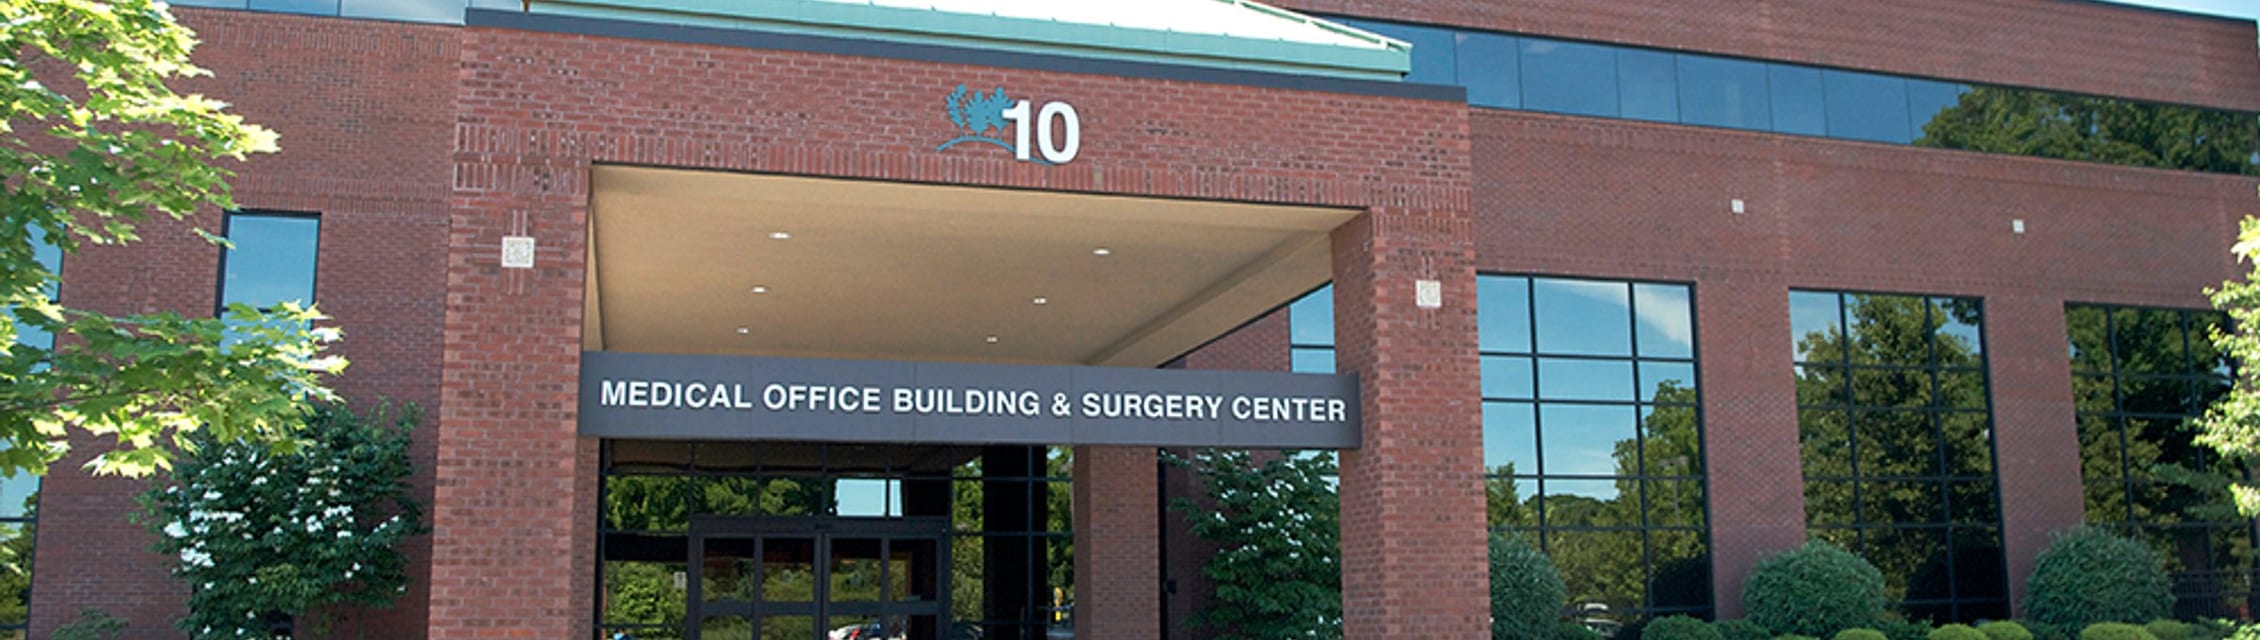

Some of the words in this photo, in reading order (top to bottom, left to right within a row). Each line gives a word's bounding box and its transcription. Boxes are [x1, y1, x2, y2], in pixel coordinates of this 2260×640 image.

[1002, 99, 1080, 163] 10
[600, 380, 753, 408] MEDICAL
[763, 383, 882, 411] OFFICE
[893, 388, 1041, 416] BUILDING
[1051, 391, 1072, 416] &
[1082, 392, 1224, 419] SURGERY
[1232, 395, 1346, 422] CENTER
